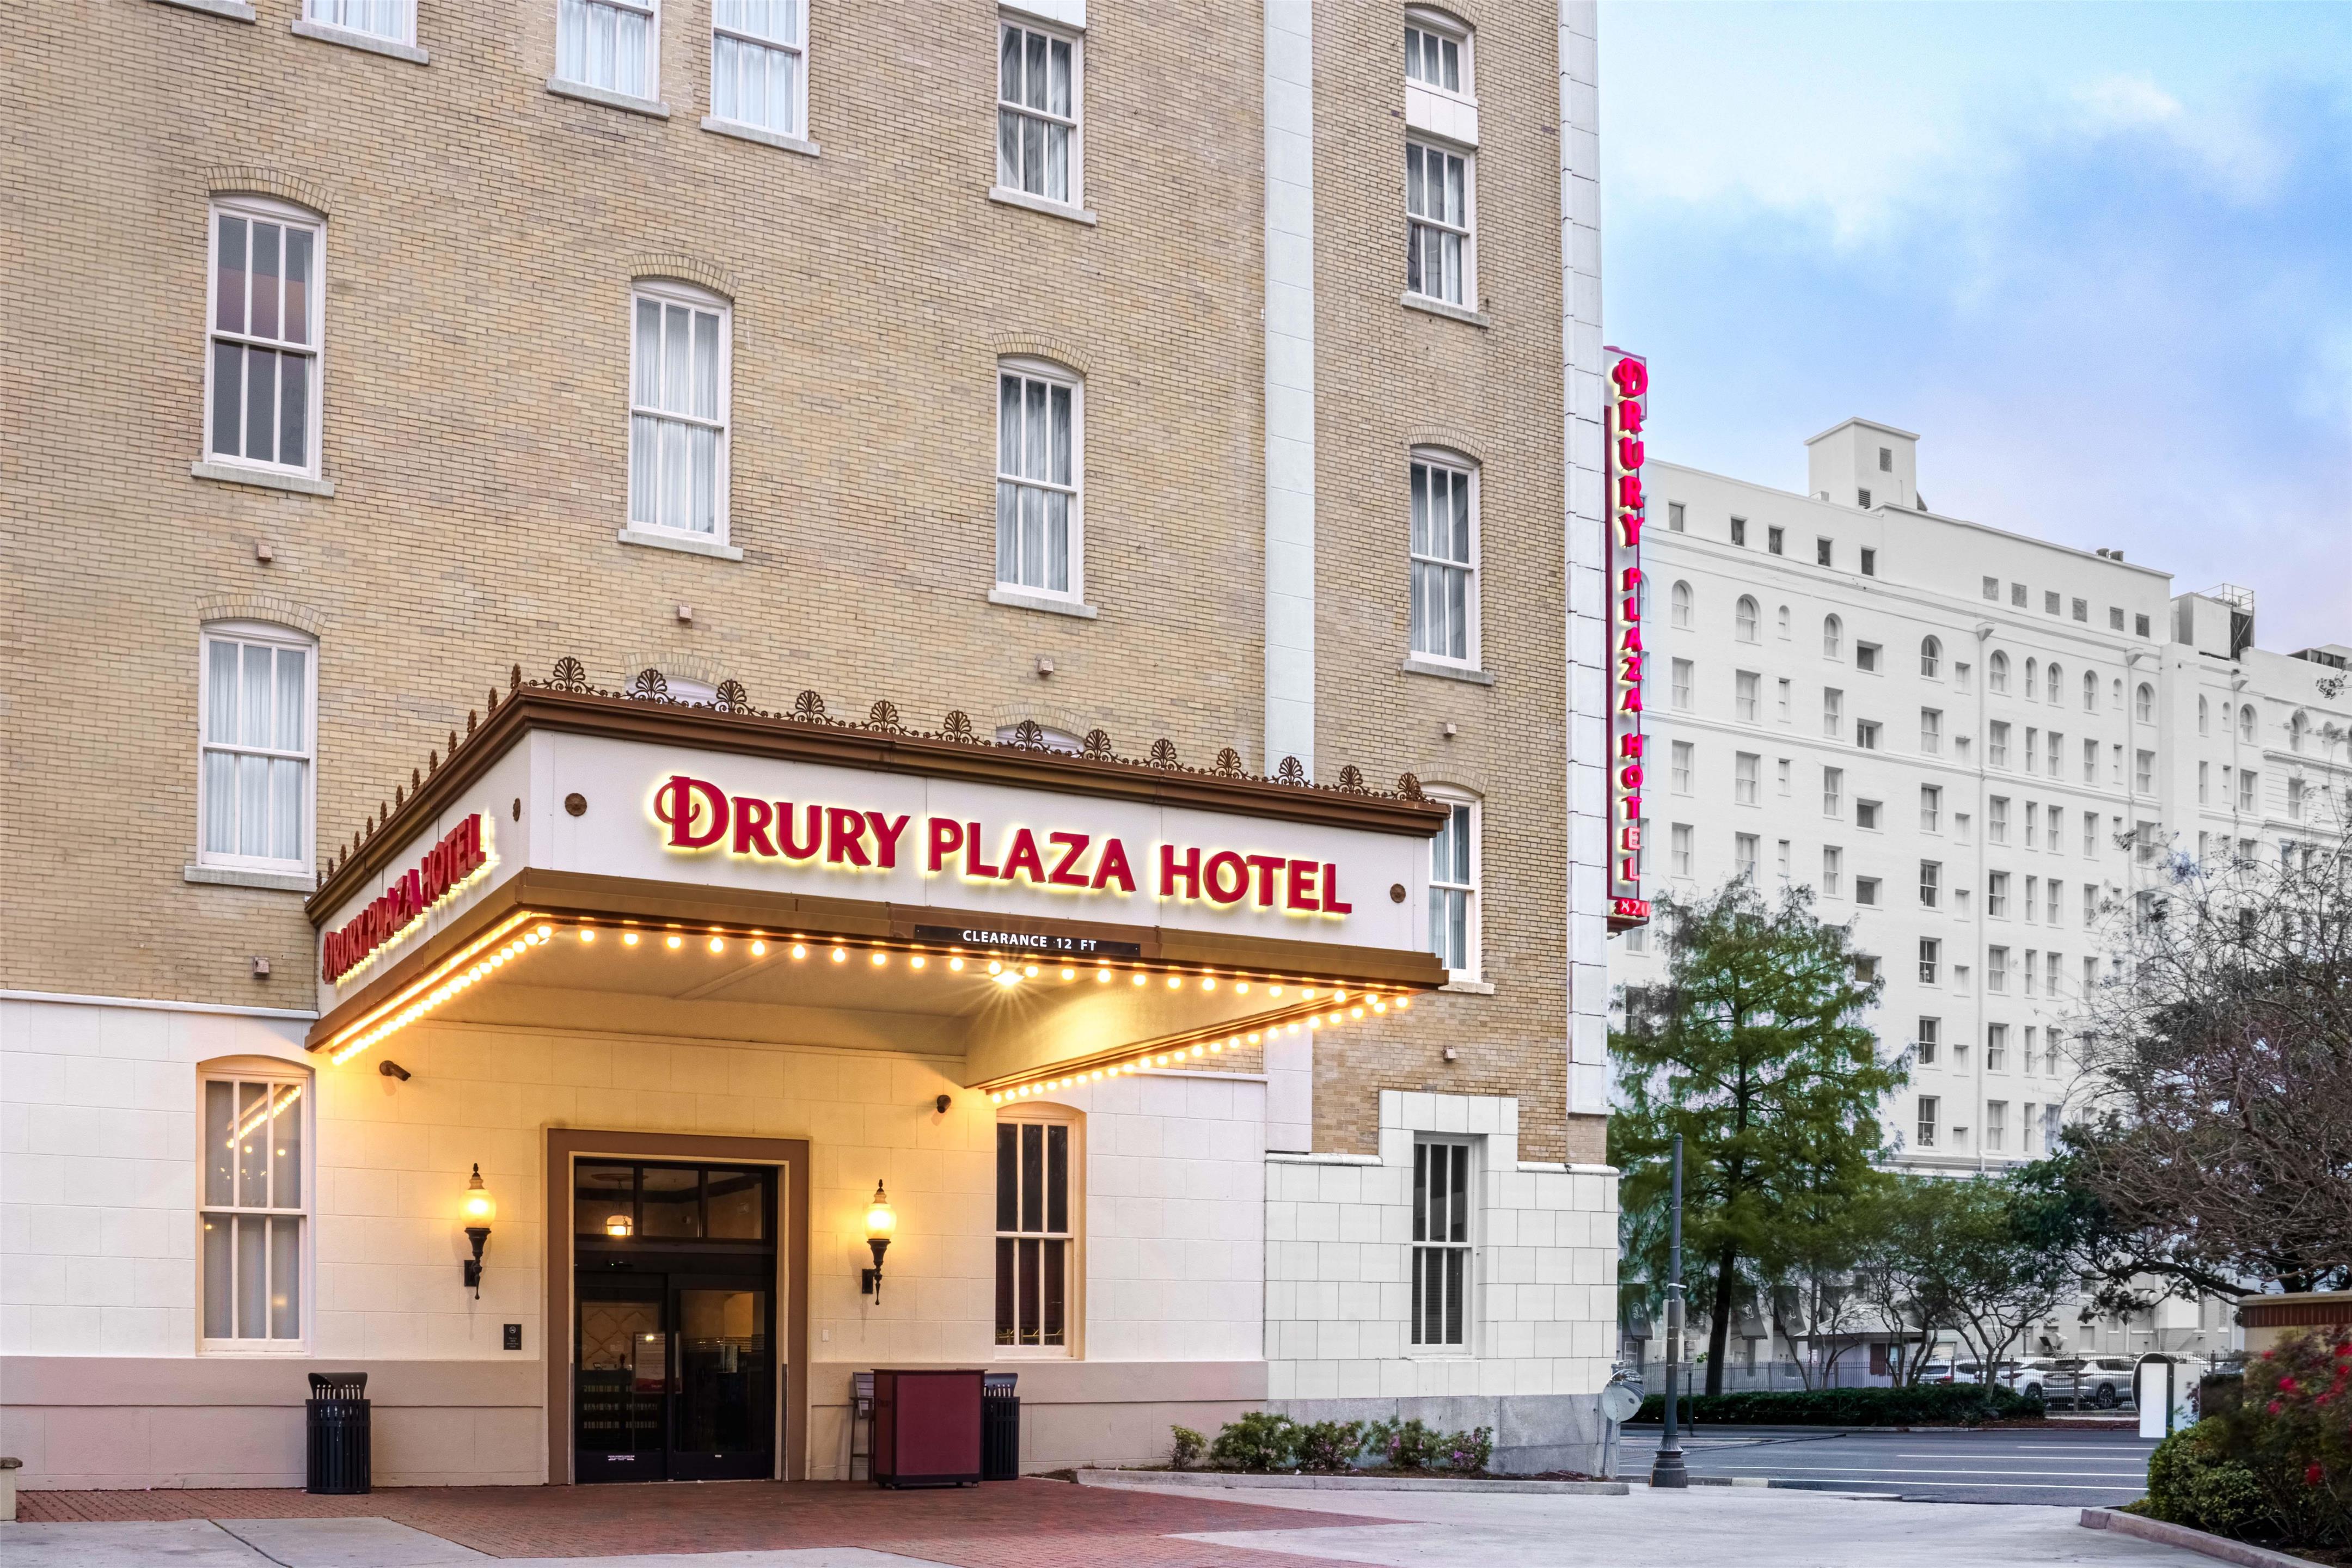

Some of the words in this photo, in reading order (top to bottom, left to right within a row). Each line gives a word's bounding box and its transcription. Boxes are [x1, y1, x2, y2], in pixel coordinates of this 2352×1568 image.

[1612, 357, 1648, 548] DRURY
[1621, 567, 1643, 713] PLAZA
[653, 775, 911, 869] DRURY
[928, 817, 1137, 892] PLAZA
[1160, 844, 1352, 915] HOTEL
[1620, 733, 1644, 881] HOTEL
[323, 909, 370, 985] DRURY
[367, 869, 422, 950] PLAZA
[421, 813, 486, 908] HOTEL
[963, 930, 1047, 948] CLEARANCE
[1056, 938, 1072, 950] 12
[1081, 940, 1097, 951] FT
[1615, 898, 1651, 917] 820
